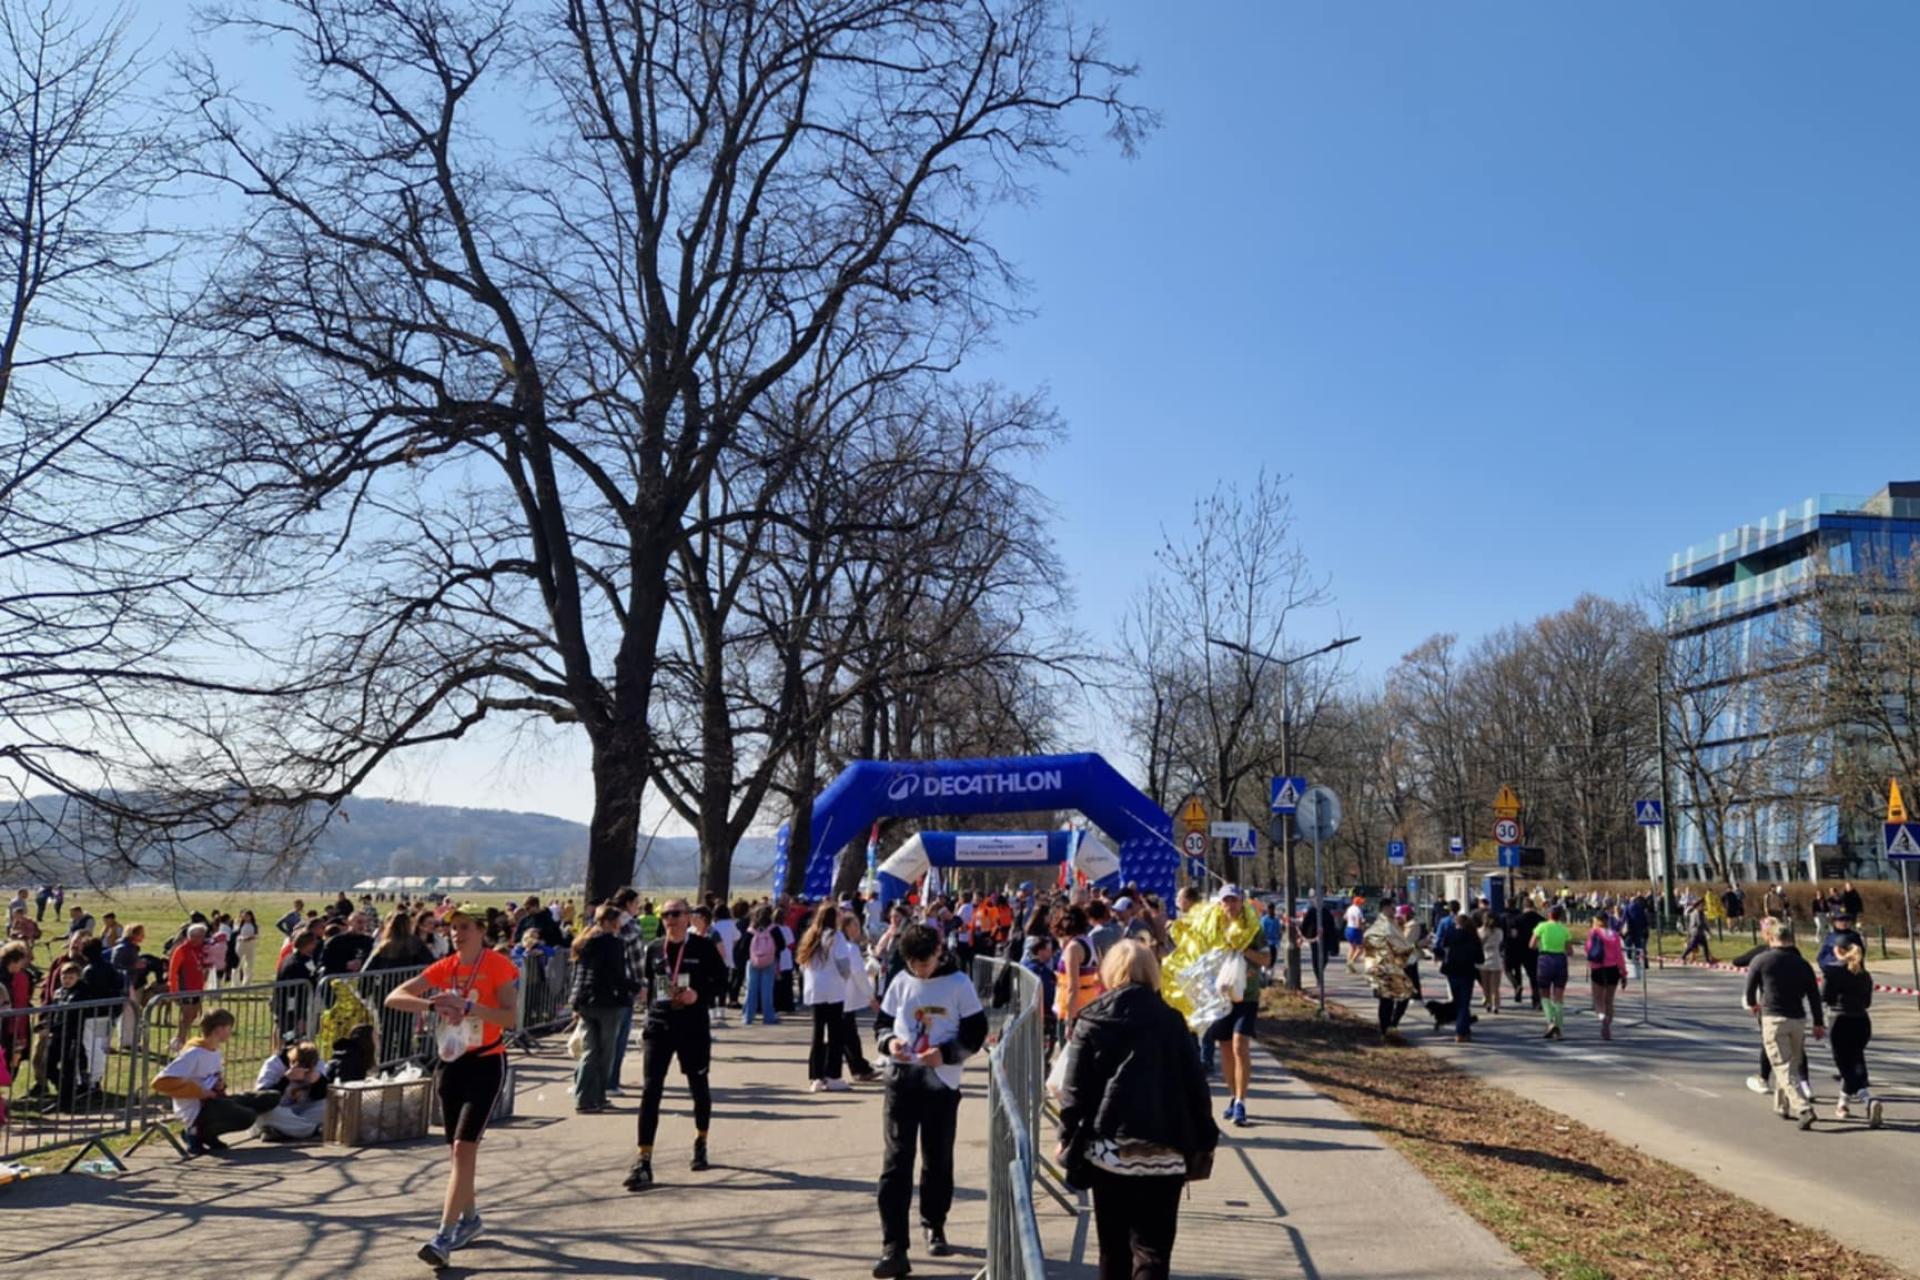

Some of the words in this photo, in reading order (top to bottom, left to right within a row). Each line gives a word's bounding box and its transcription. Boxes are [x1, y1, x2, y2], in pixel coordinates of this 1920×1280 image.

[923, 770, 1062, 797] DECATHLON
[1499, 824, 1517, 838] 30
[1187, 836, 1203, 850] 30
[1391, 843, 1401, 856] P
